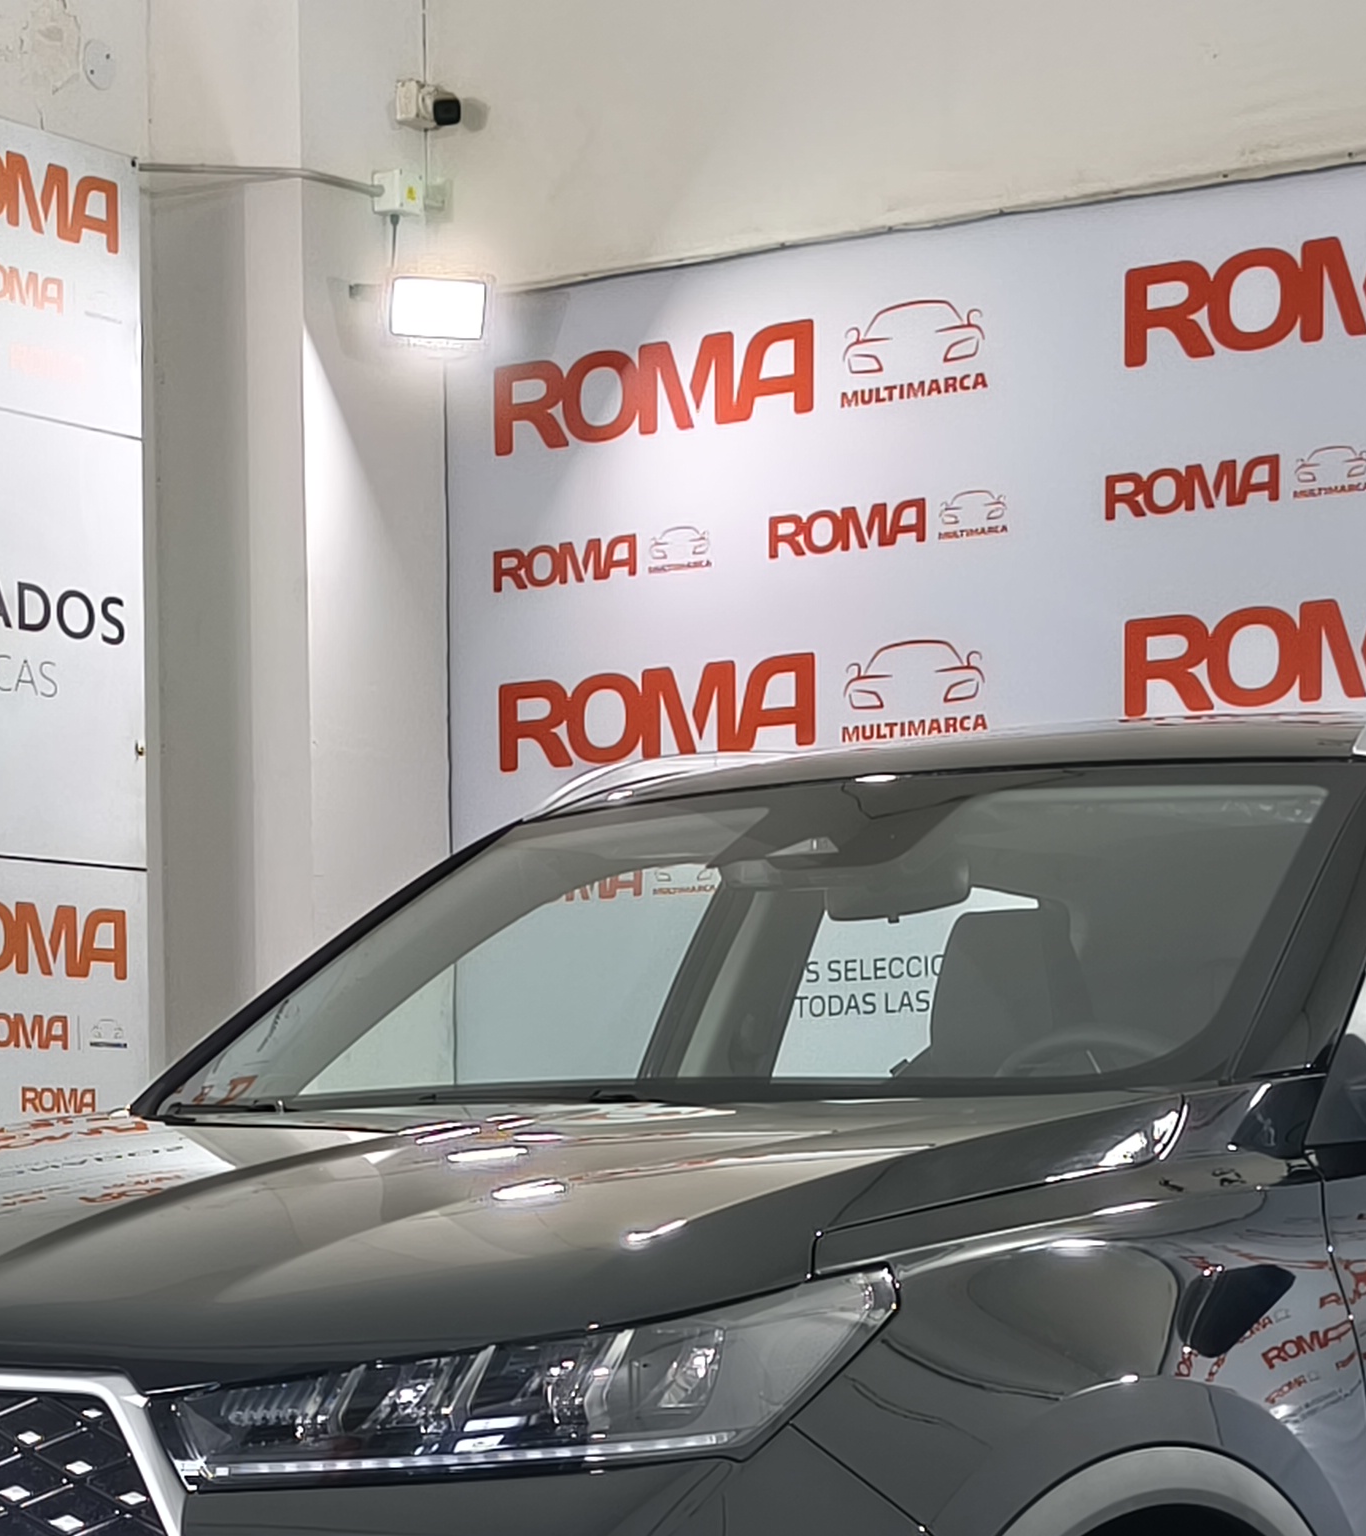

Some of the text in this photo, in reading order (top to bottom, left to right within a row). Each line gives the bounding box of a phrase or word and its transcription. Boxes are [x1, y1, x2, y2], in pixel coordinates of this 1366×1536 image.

[494, 318, 815, 457] ROMA
[840, 372, 989, 408] MULTIMARCA
[1105, 454, 1281, 522] ROMA
[768, 497, 927, 560] ROMA
[493, 533, 637, 593] ROMA
[498, 651, 817, 773] ROMA
[841, 714, 989, 744] MULTIMARCA
[794, 990, 931, 1018] TODAS LAS
[21, 1087, 97, 1114] ROMA
